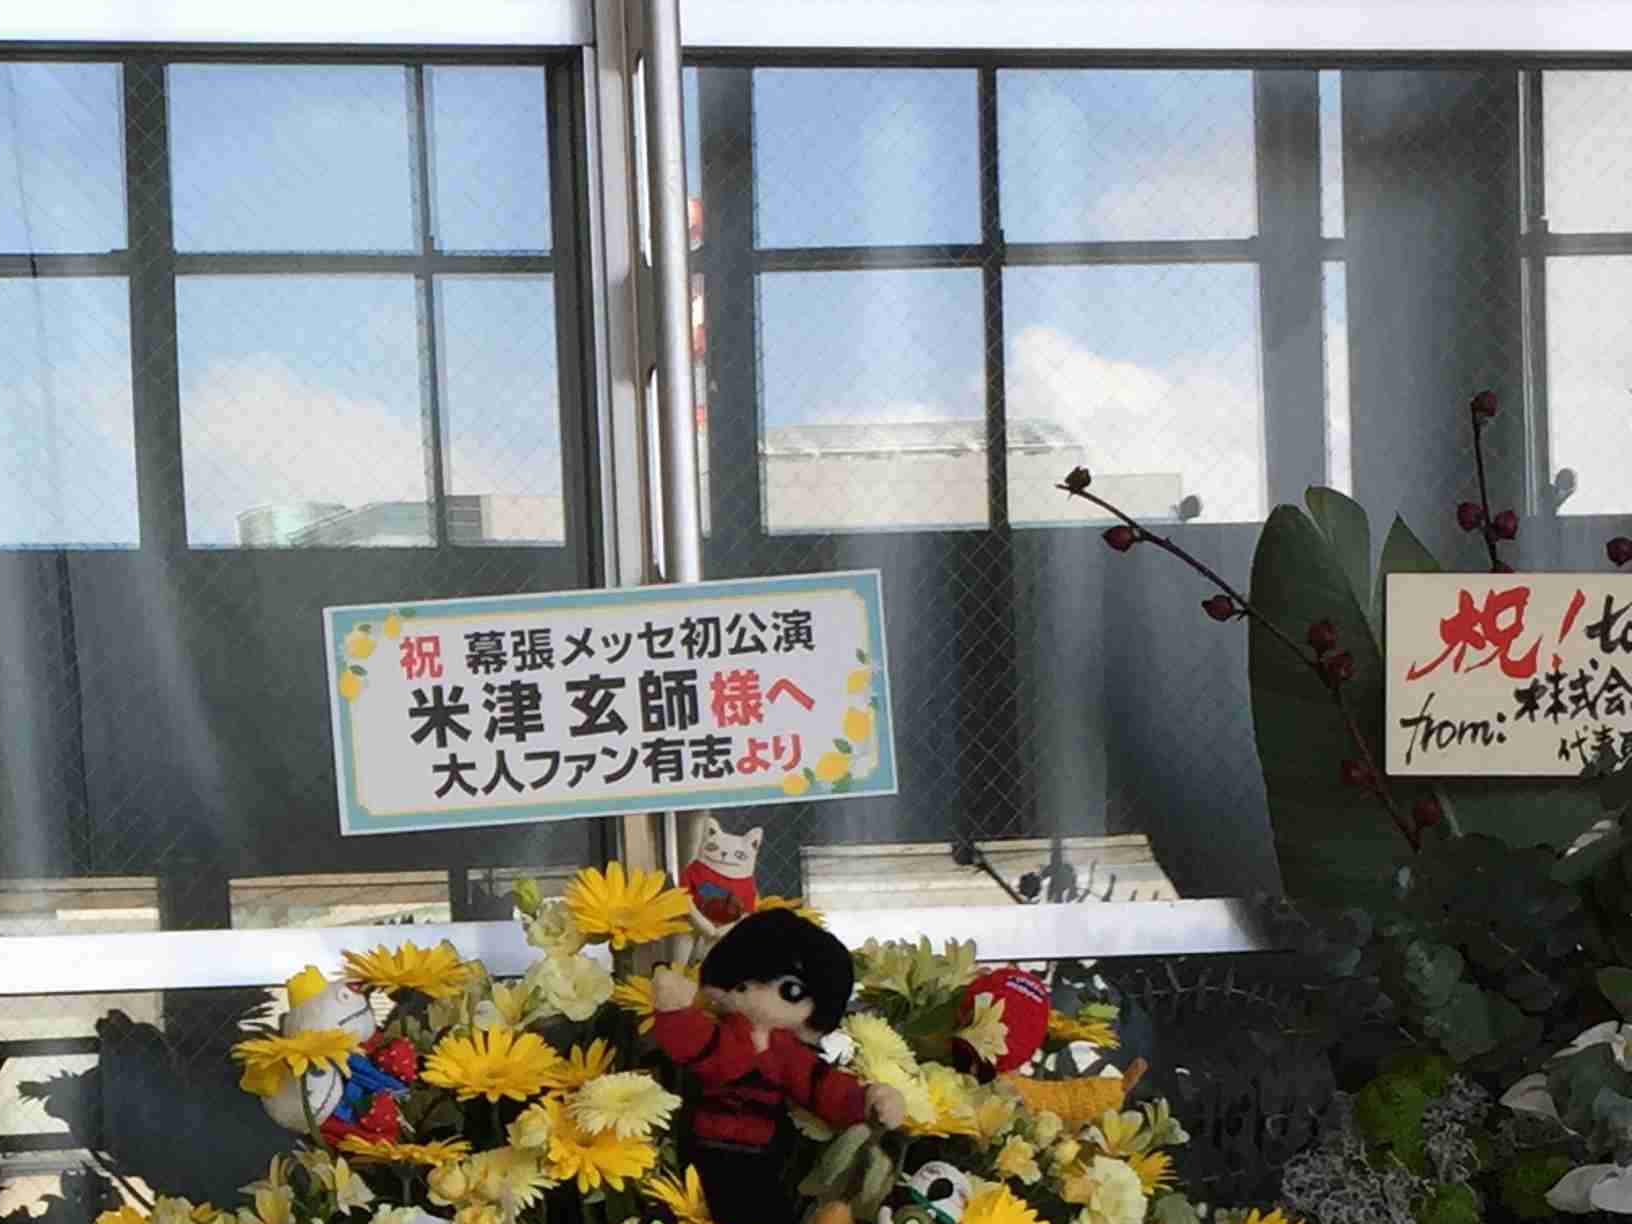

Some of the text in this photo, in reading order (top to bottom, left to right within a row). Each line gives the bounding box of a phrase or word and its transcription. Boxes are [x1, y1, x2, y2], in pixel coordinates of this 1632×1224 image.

[463, 609, 816, 675] 幕張メッセ初公演
[432, 734, 803, 798] 大人ファン有志より
